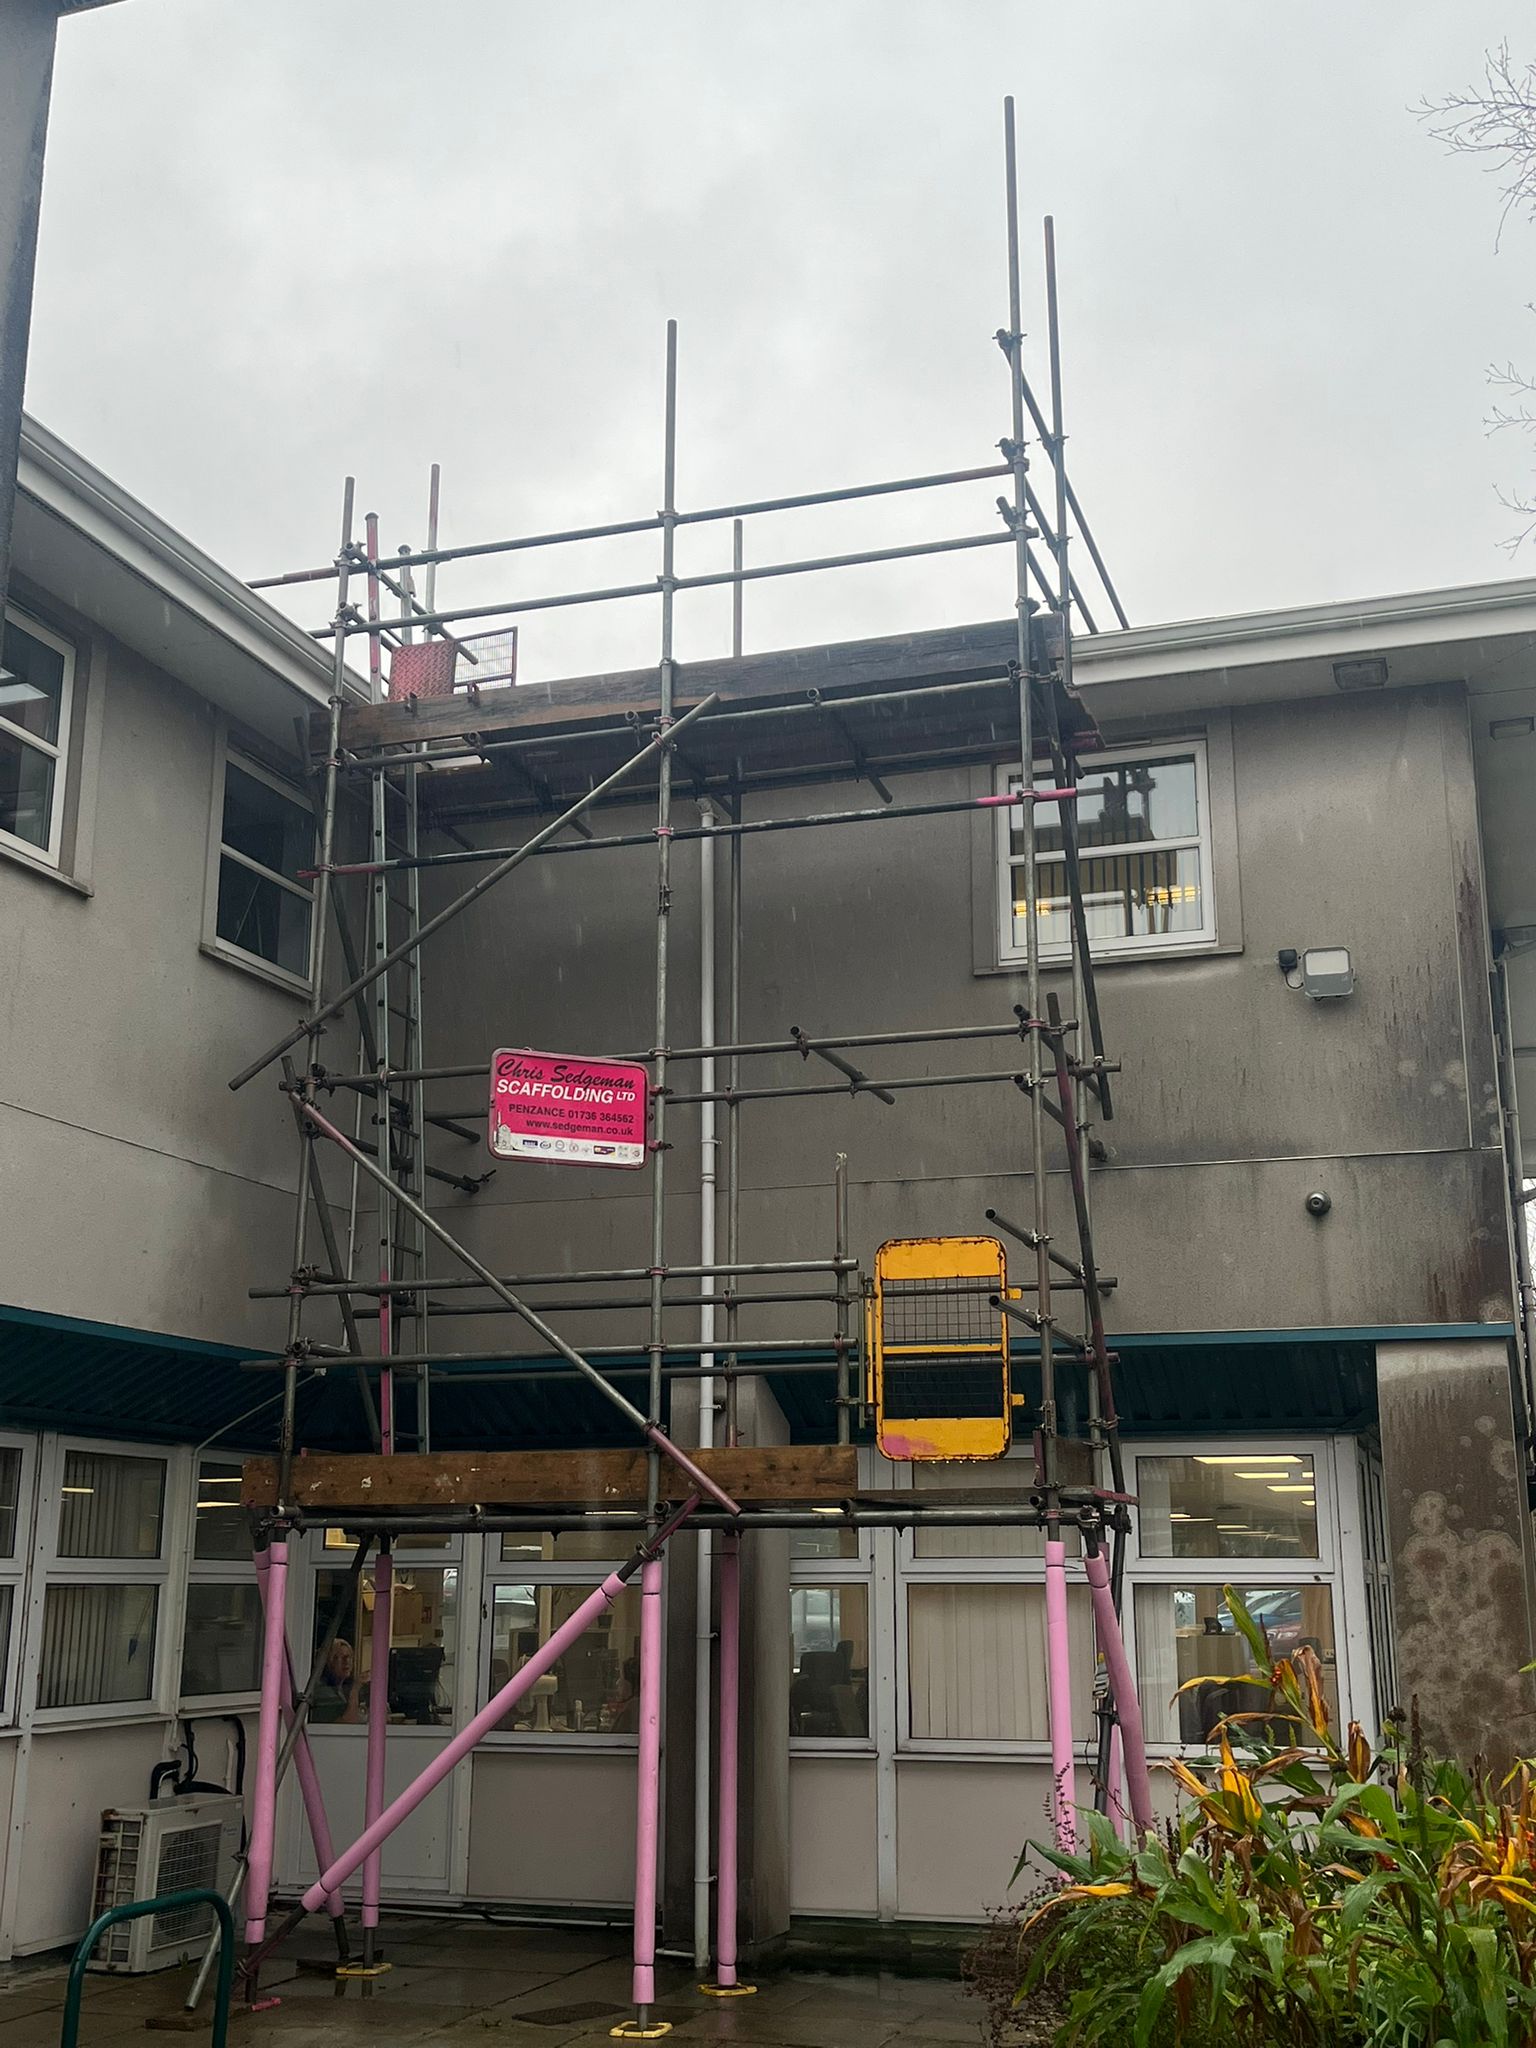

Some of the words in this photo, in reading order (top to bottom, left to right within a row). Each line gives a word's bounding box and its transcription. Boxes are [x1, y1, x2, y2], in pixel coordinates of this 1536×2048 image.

[497, 1059, 543, 1080] Chris
[551, 1065, 635, 1089] Sedgeman
[497, 1079, 614, 1104] SCAFFOLDING
[616, 1090, 636, 1102] LTD
[509, 1104, 565, 1118] PENZANCE
[568, 1111, 597, 1121] 01736
[526, 1119, 633, 1136] www.sedgeman.co.uk
